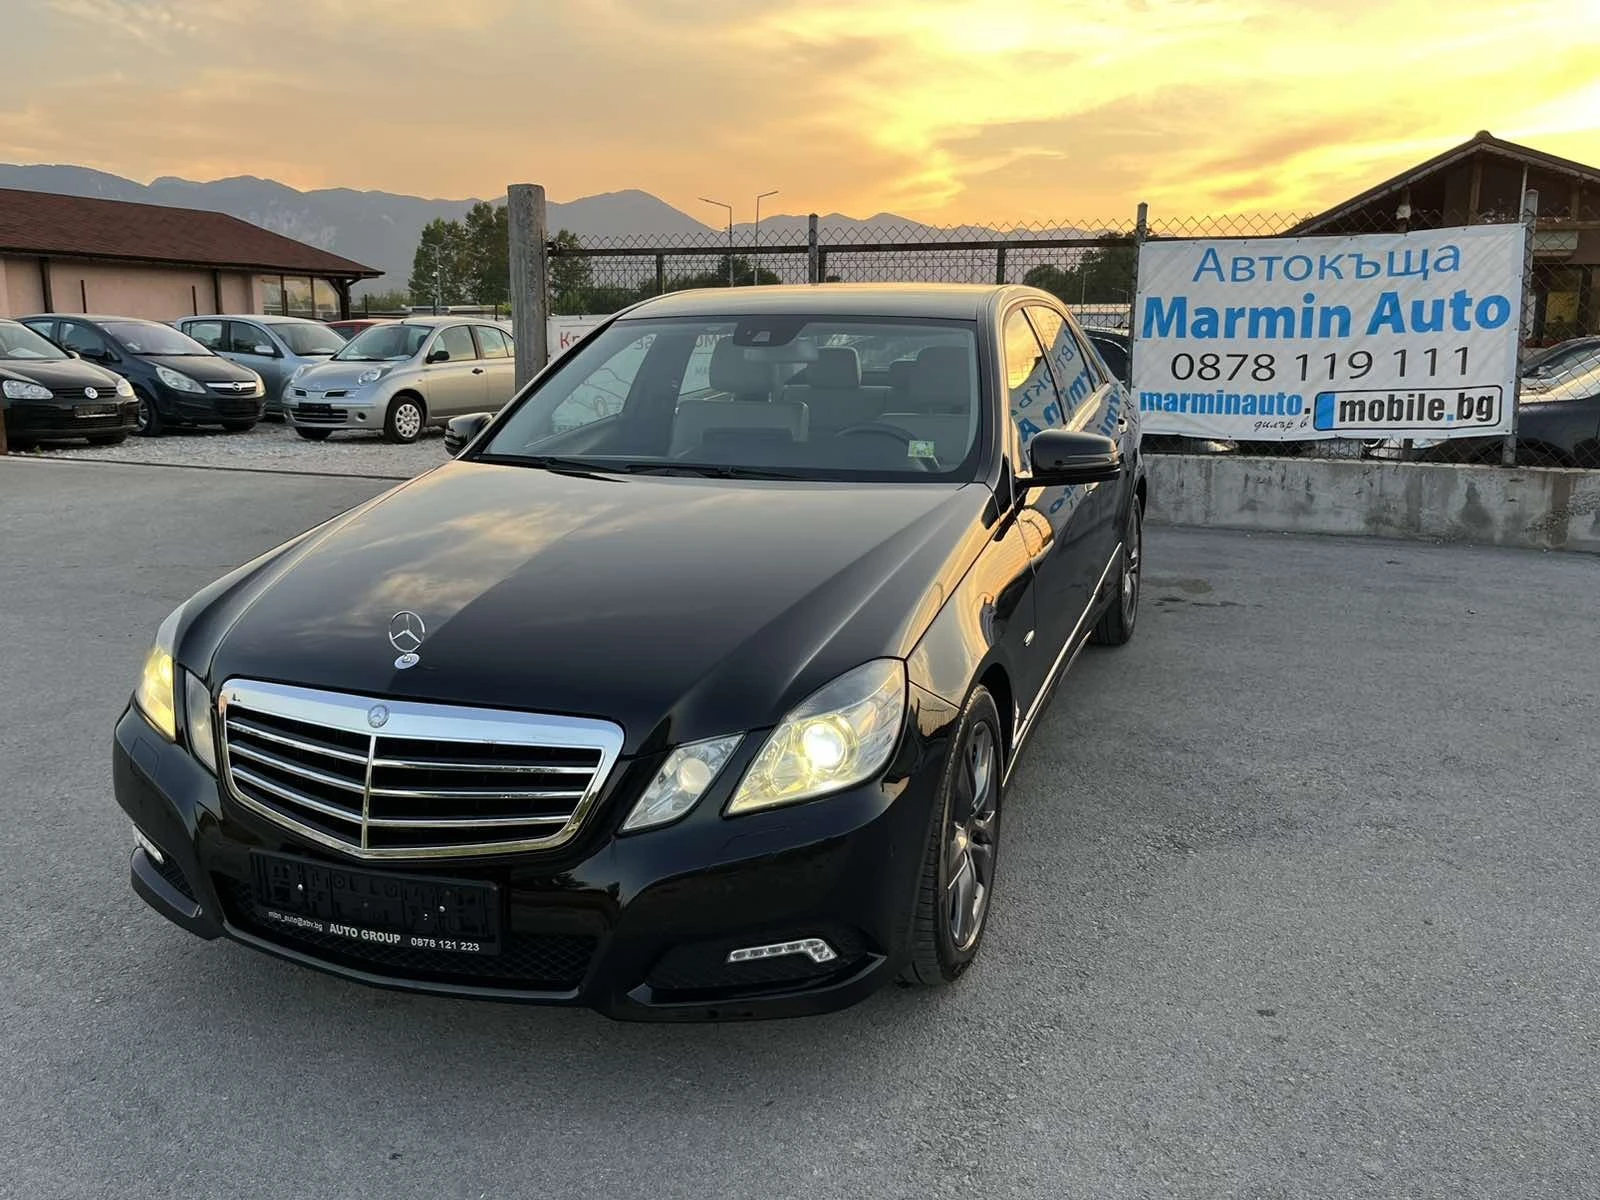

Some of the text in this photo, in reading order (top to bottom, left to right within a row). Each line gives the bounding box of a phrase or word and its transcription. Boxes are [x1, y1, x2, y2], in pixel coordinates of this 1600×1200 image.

[1192, 244, 1460, 282] Автокъща
[1142, 289, 1511, 339] Marmin Auto
[1171, 347, 1468, 382] 0878 119 111
[1339, 392, 1494, 422] mobile.bg
[329, 923, 358, 937] AUTO
[360, 929, 401, 944] GROUP
[438, 940, 457, 950] 121
[460, 941, 480, 951] 223
